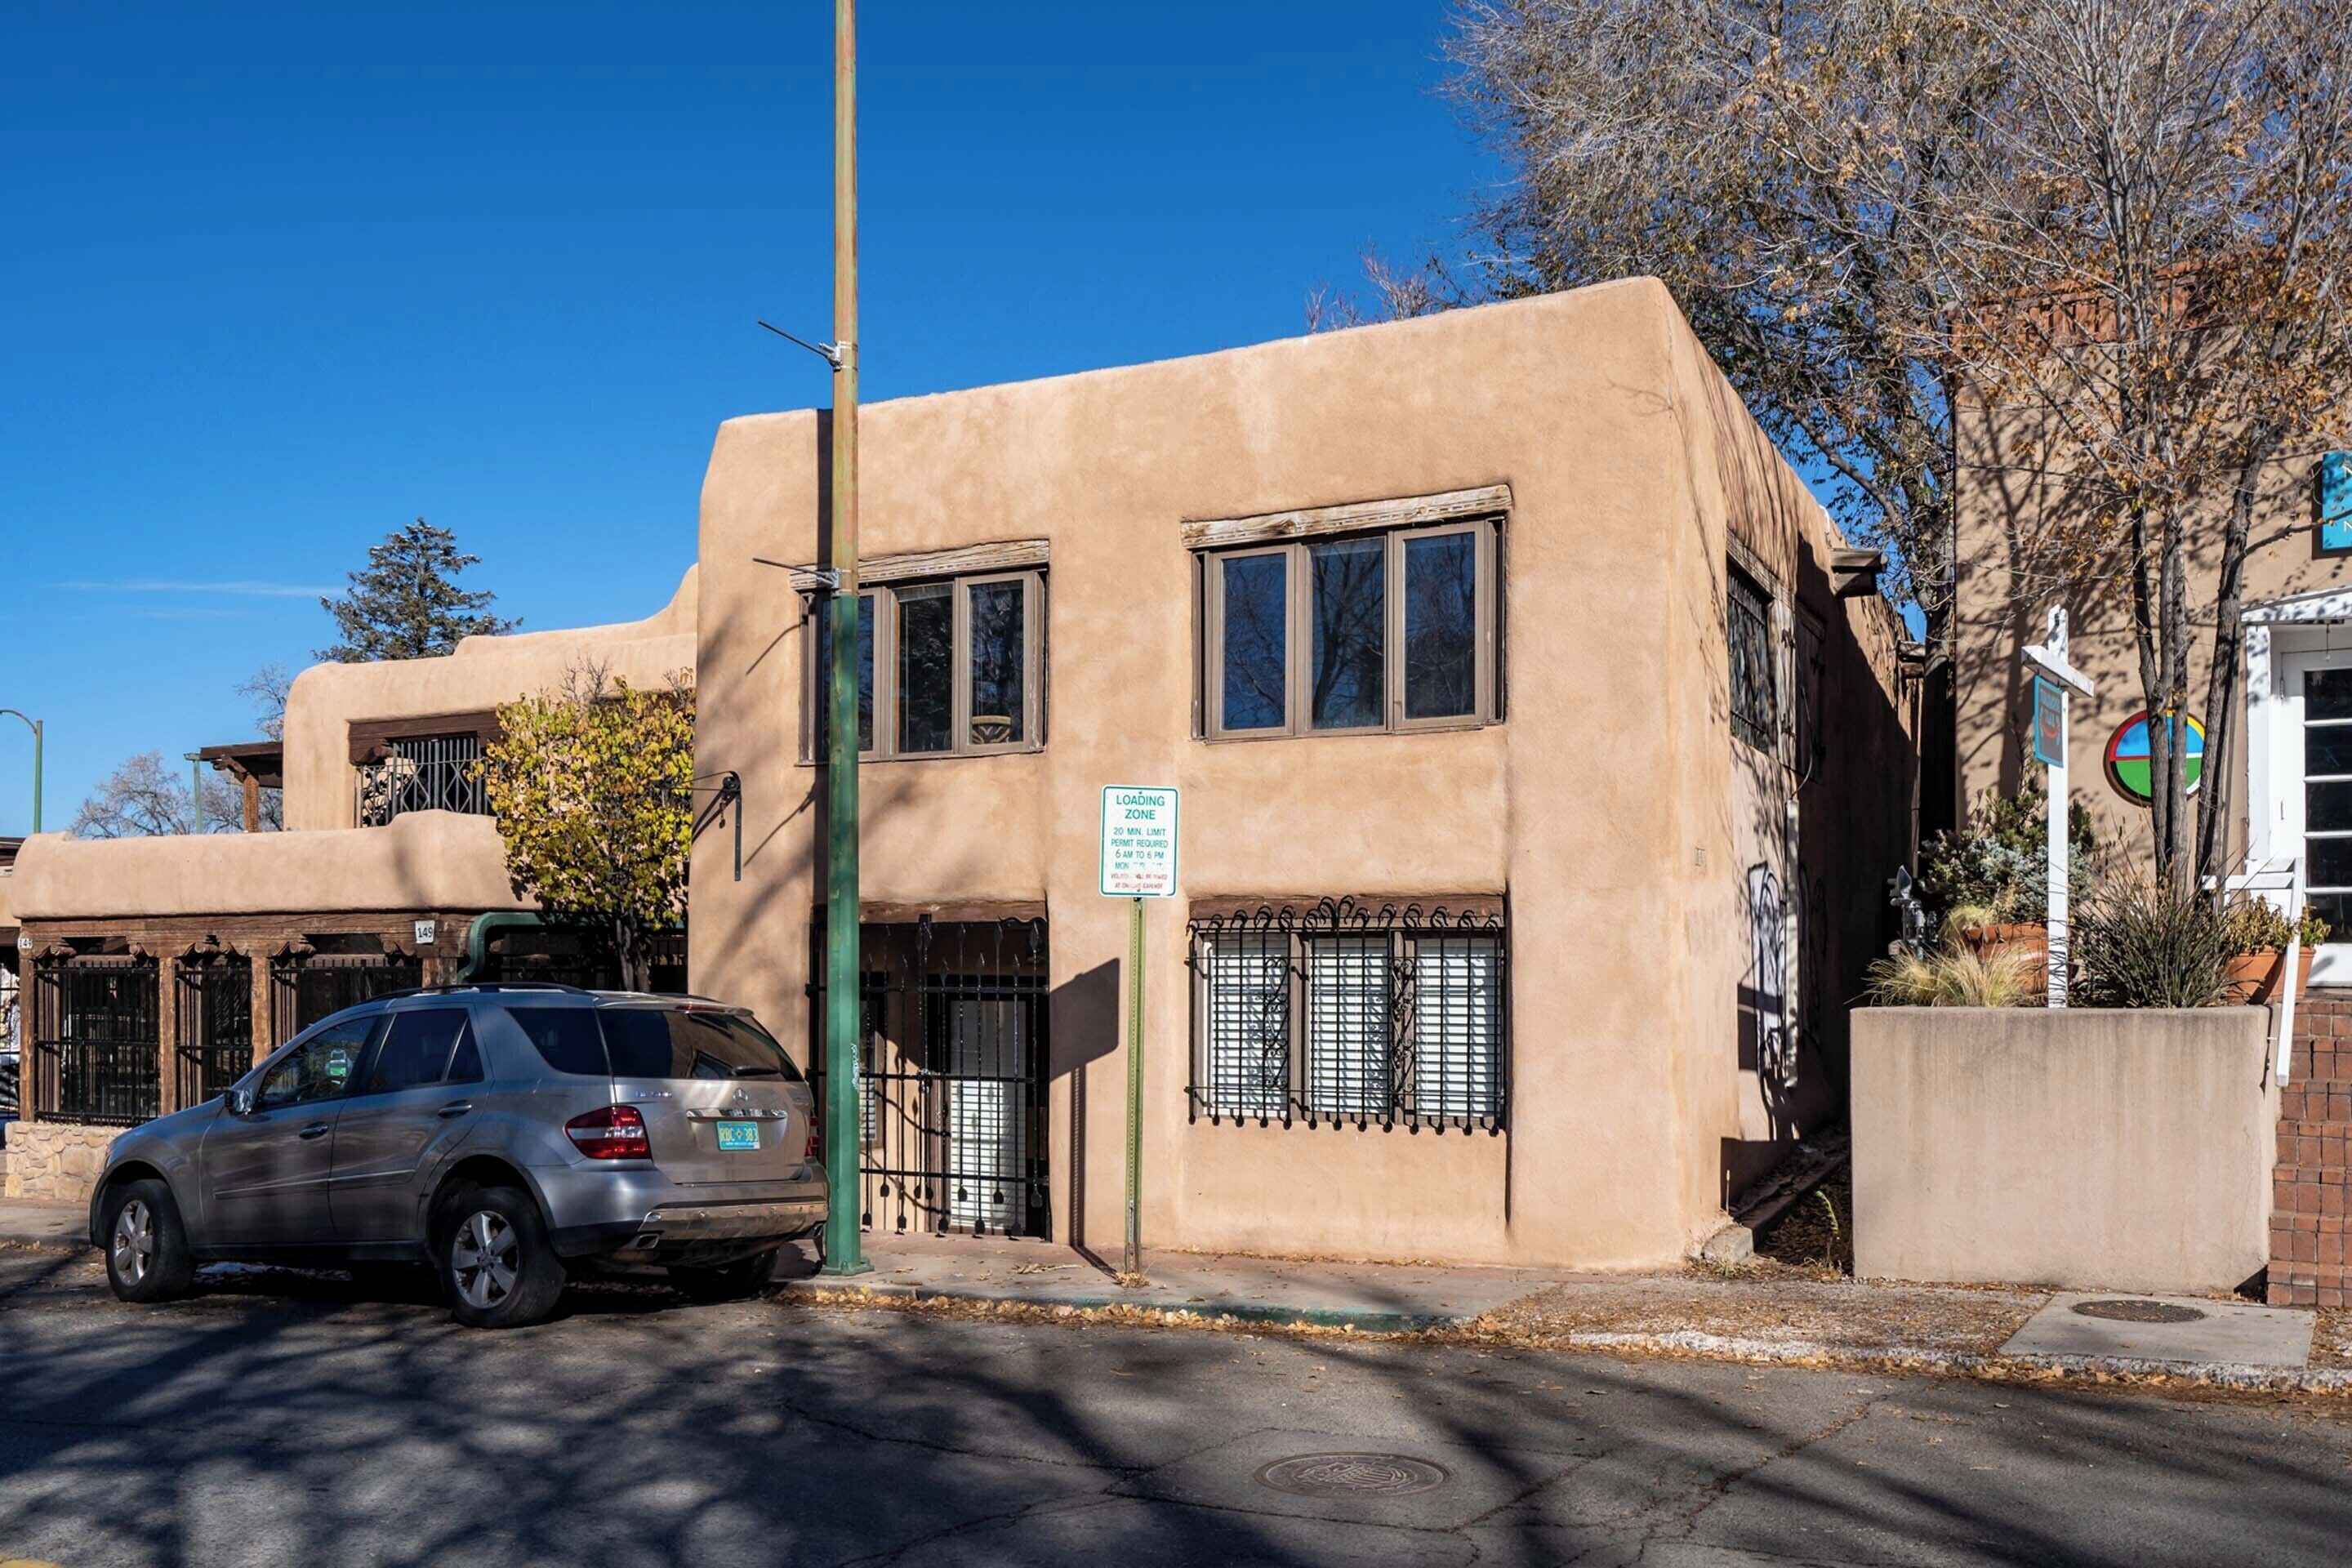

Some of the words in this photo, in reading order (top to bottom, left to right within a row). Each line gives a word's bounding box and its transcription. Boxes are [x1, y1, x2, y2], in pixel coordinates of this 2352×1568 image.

[1116, 795, 1165, 806] LOADING
[1125, 808, 1156, 820] ZONE
[1113, 826, 1124, 835] 20
[1147, 827, 1166, 836] LIMIT
[1111, 839, 1134, 847] PERMIT
[1137, 840, 1169, 849] REQUIRED
[1115, 849, 1121, 858] 6
[1115, 862, 1129, 870] MON
[417, 926, 434, 938] 149
